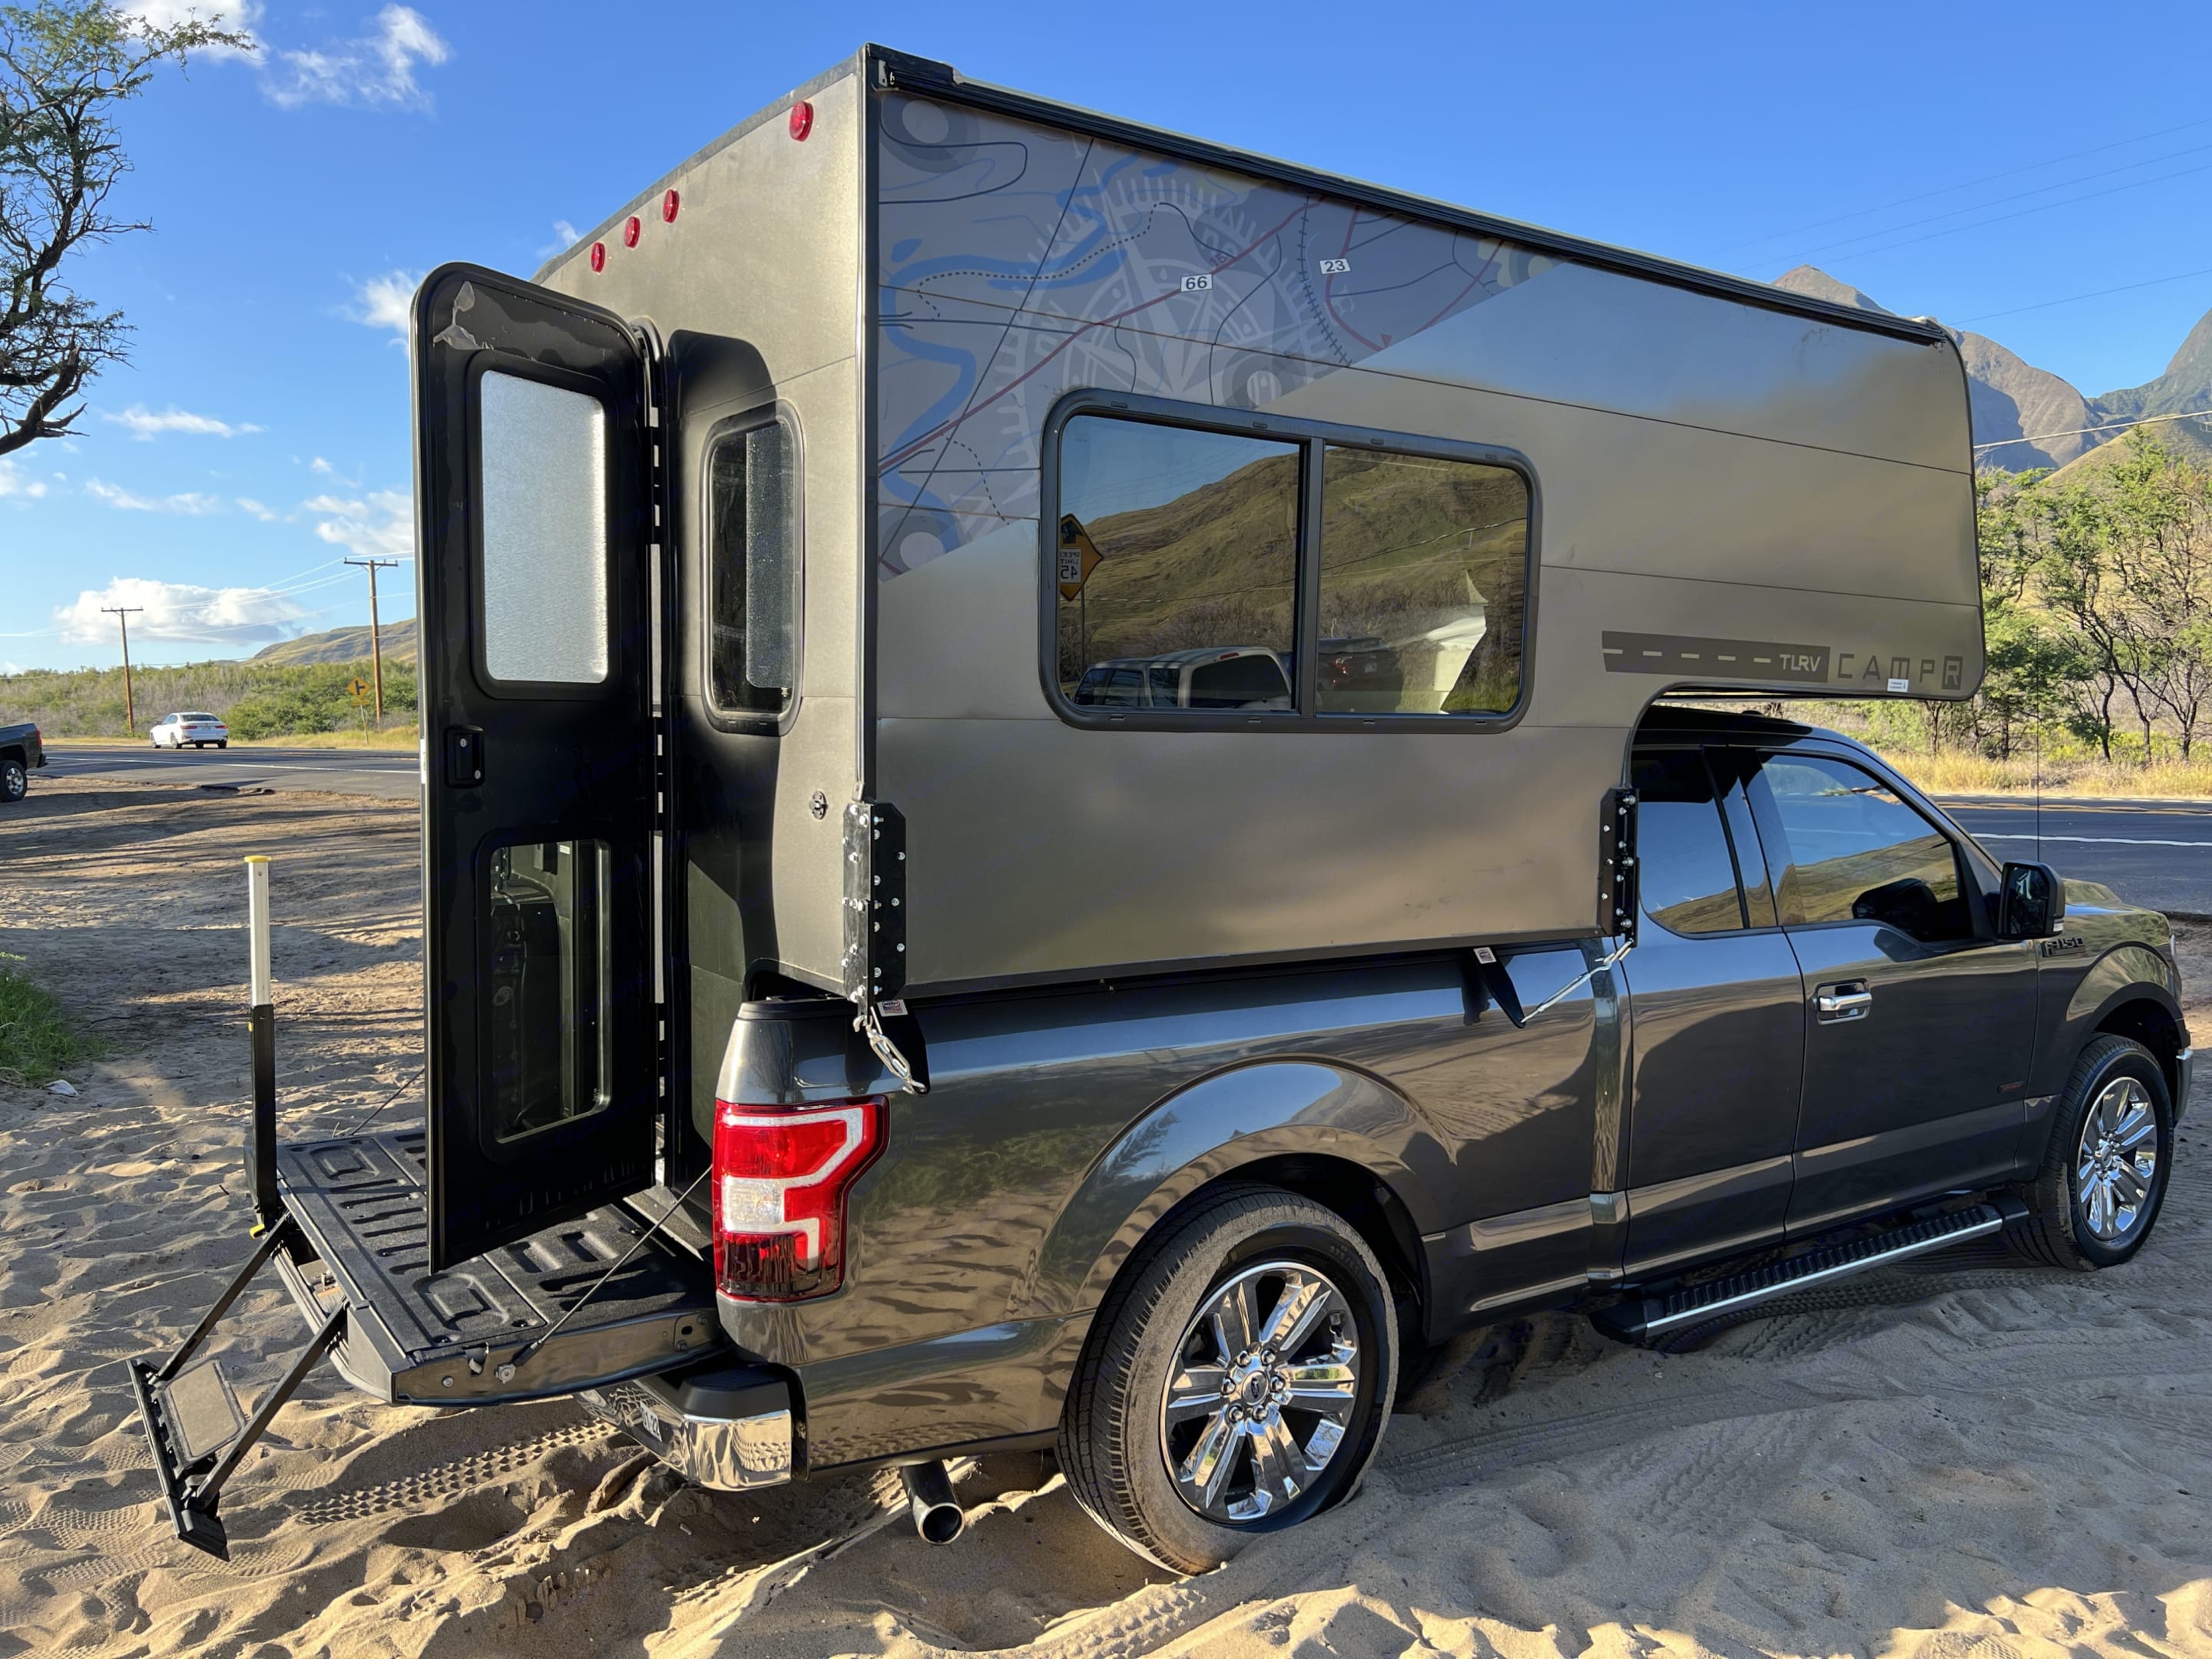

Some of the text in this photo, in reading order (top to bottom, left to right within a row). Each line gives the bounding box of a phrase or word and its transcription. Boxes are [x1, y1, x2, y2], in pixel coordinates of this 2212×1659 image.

[1323, 260, 1346, 273] 23
[1185, 276, 1207, 290] 66
[1780, 653, 1821, 672] TLRV
